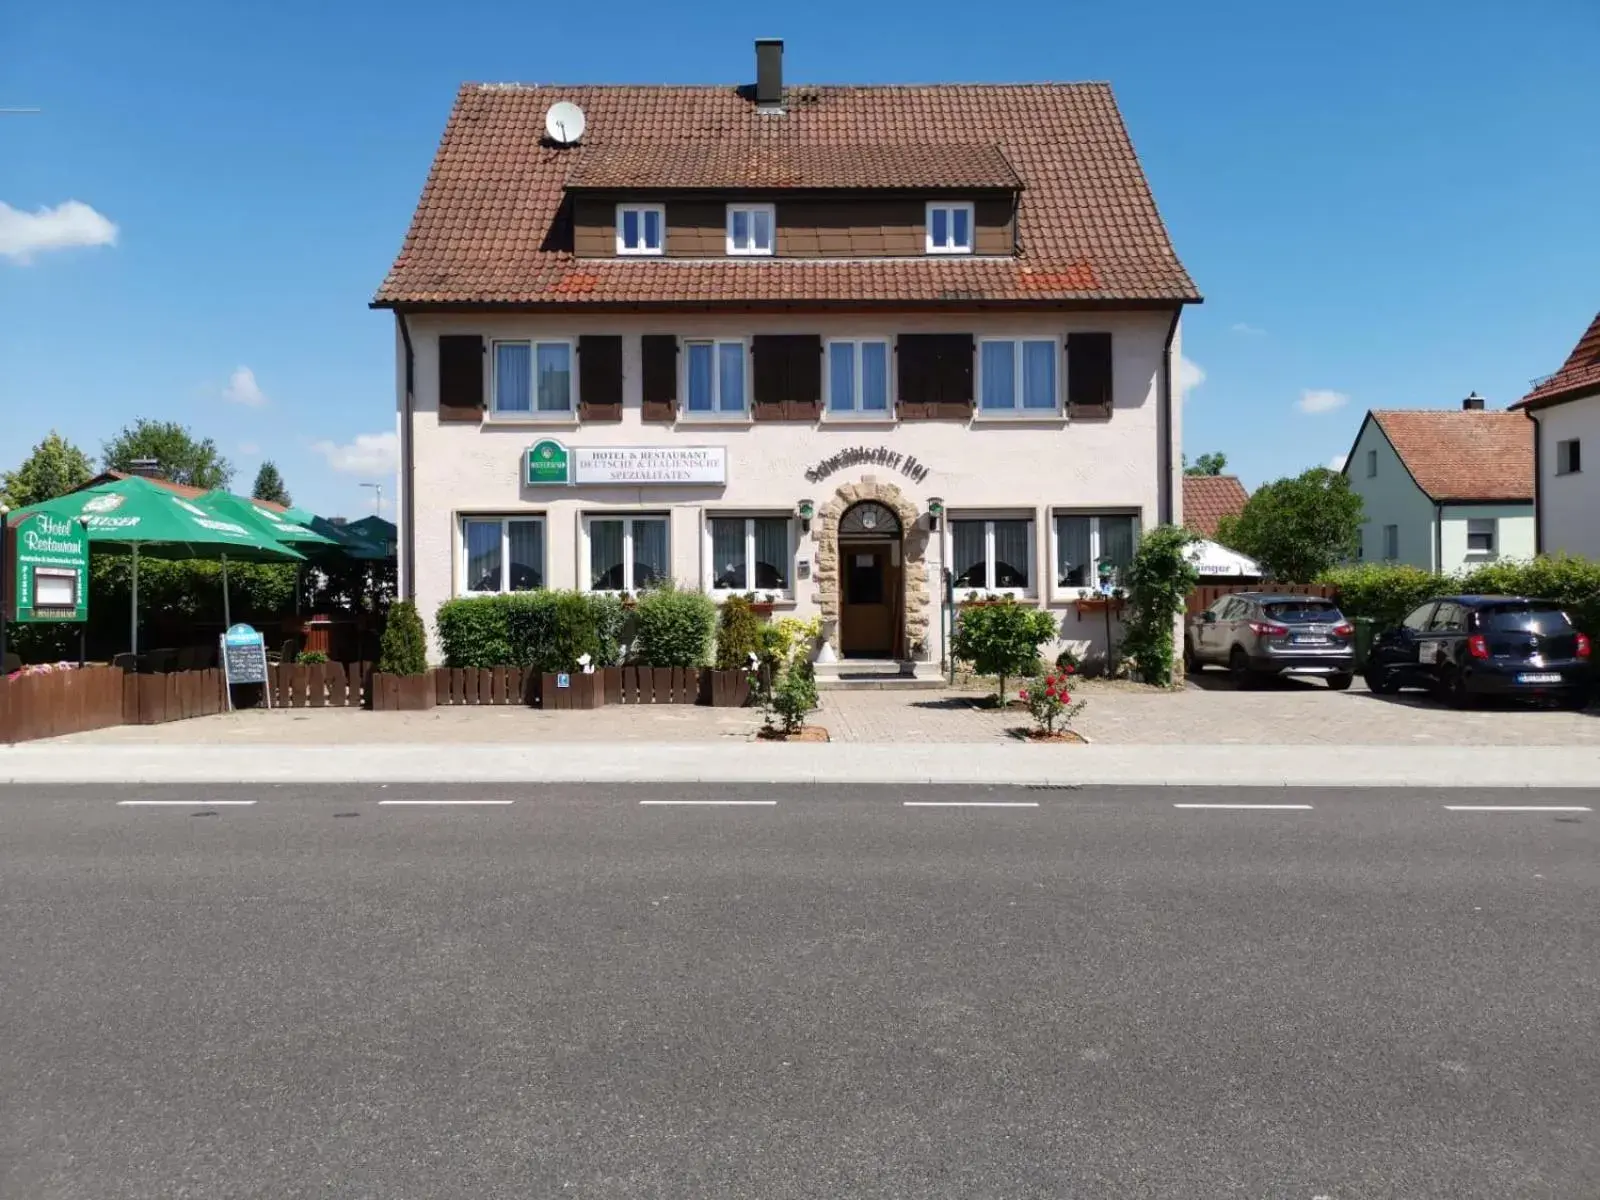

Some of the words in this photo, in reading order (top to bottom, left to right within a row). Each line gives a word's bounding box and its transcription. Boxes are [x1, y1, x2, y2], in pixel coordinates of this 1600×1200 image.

[580, 459, 633, 468] DEUTSCHE
[647, 459, 720, 468] ITALIENISCHE
[592, 451, 625, 460] HOTEL
[629, 451, 638, 460] &
[640, 451, 709, 460] RESTAURANT
[901, 455, 931, 485] Hof
[37, 514, 72, 536] Hotel
[24, 531, 81, 554] Restaurant
